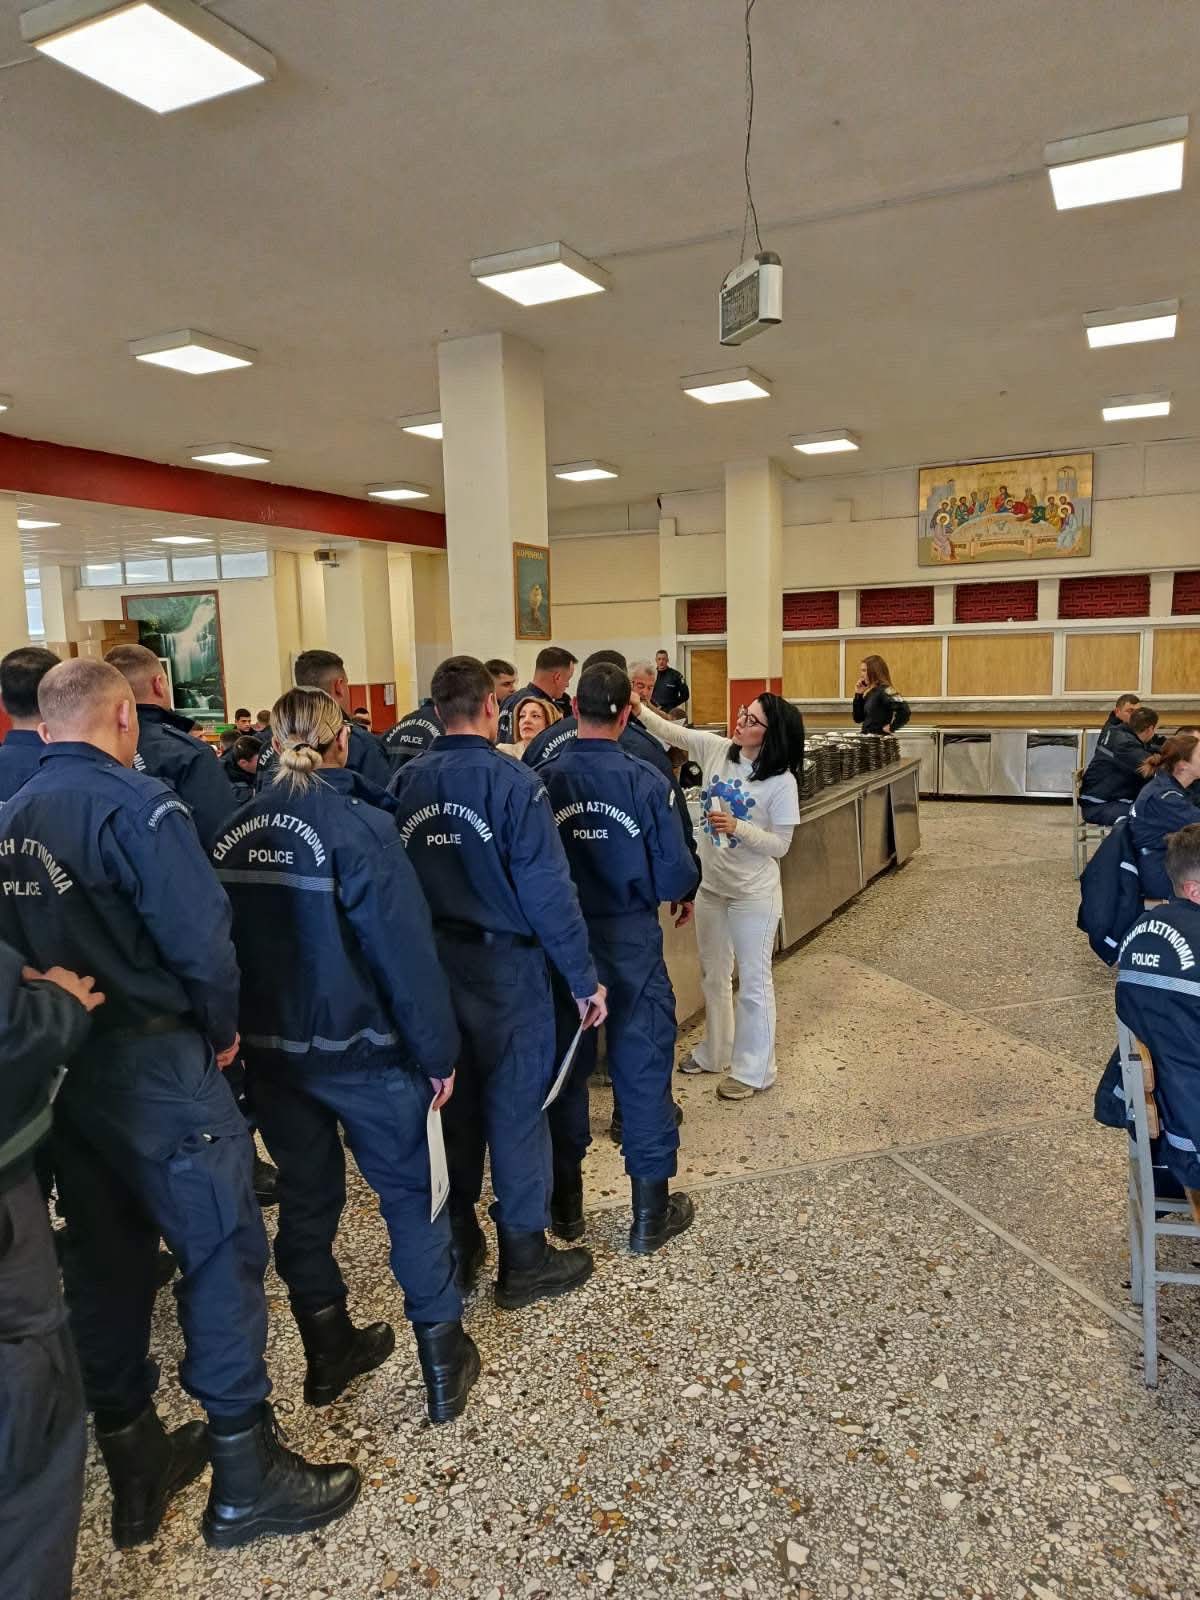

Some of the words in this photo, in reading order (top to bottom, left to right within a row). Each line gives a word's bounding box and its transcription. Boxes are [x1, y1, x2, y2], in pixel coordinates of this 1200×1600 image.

[400, 735, 423, 745] POLICE
[542, 729, 578, 759] ΕΛΛΗΝΙΚΗ
[586, 801, 640, 838] ΑΣΤΥΝΟΜΙΑ
[213, 814, 270, 861] ΕΛΛΗΝΙΚΗ
[271, 813, 326, 867] ΑΣΤΥΝΟΜΙΑ
[573, 829, 608, 839] POLICE
[248, 849, 294, 864] POLICE
[1147, 919, 1196, 971] ΑΣΤΥΝΟΜΙΑ
[1131, 952, 1160, 967] POLICE
